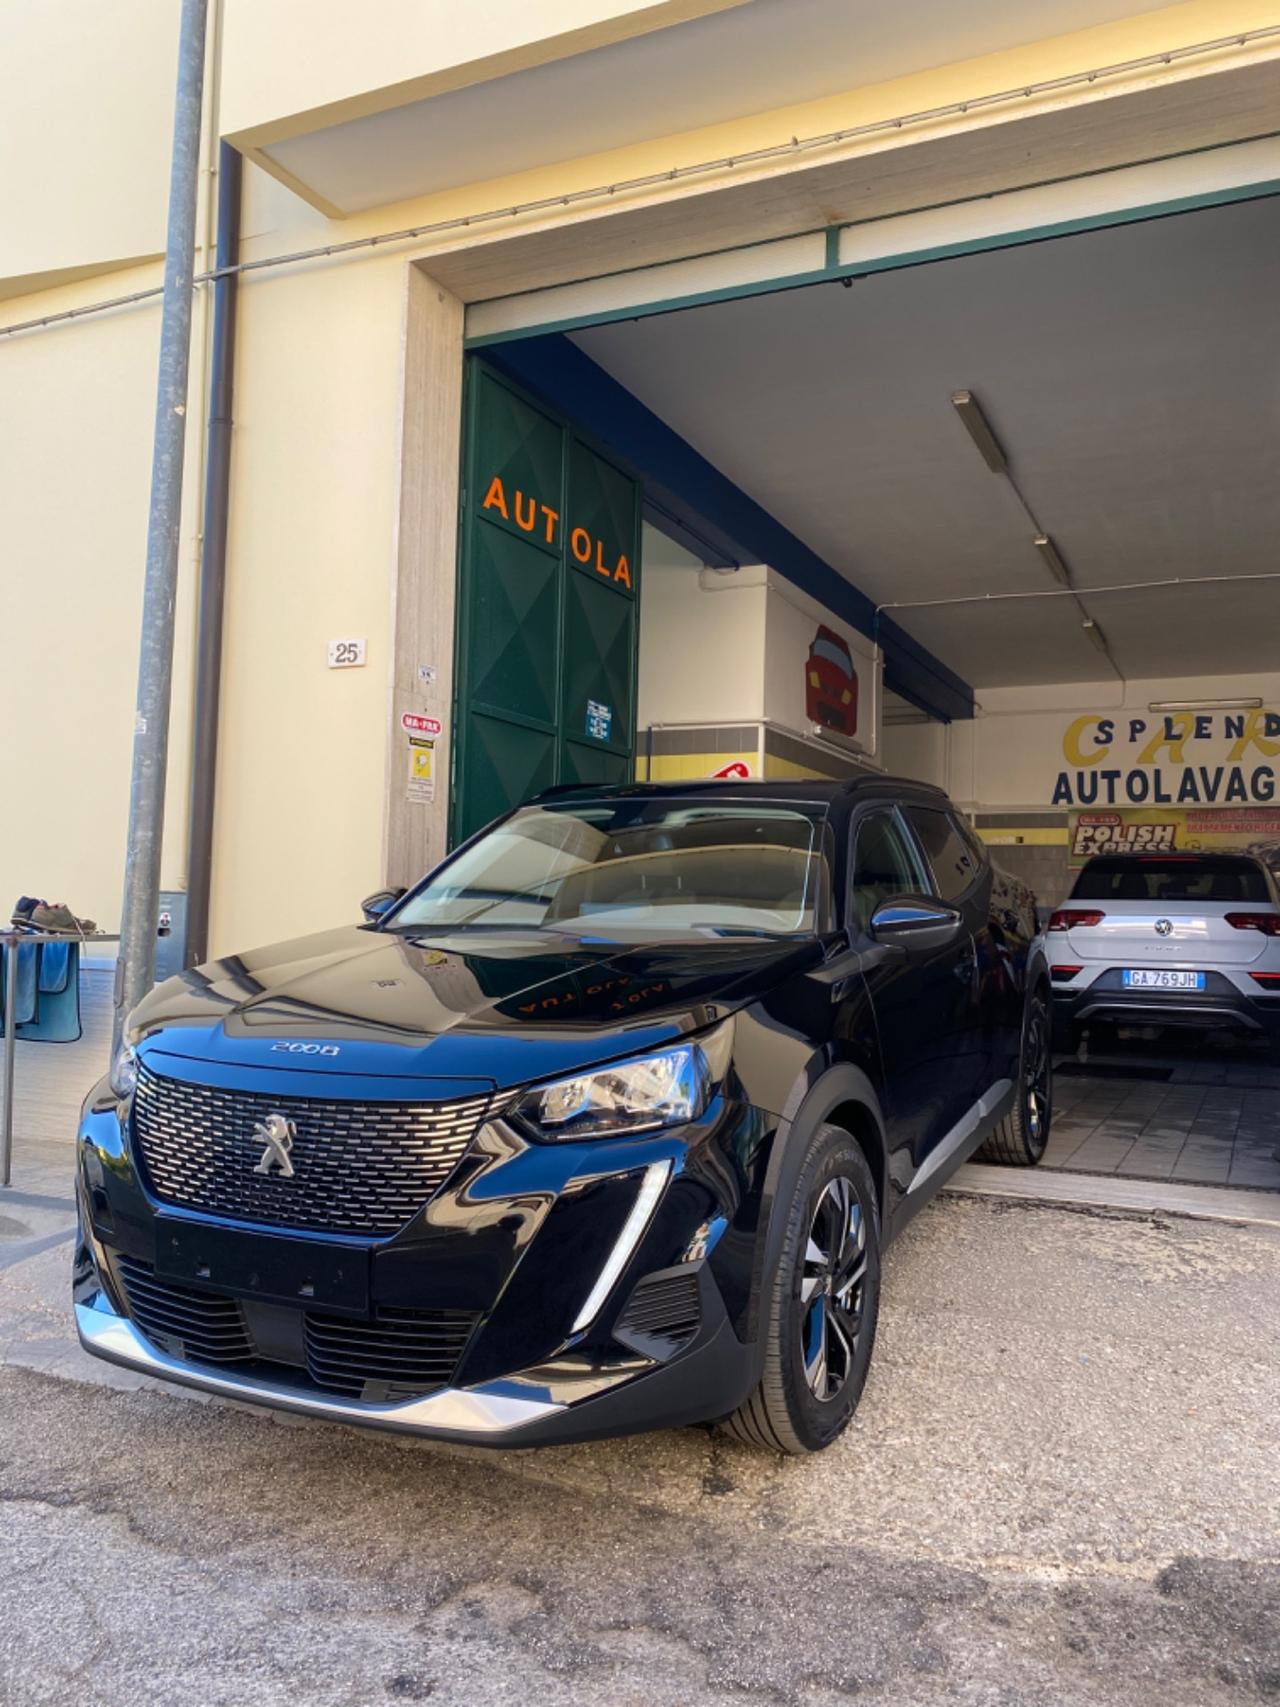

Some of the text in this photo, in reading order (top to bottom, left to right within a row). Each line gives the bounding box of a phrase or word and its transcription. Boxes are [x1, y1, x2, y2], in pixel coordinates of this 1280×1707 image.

[335, 643, 358, 663] 25
[1051, 765, 1275, 805] AUTOLAVAG
[1076, 824, 1176, 843] POLISH
[270, 1041, 340, 1056] 2008
